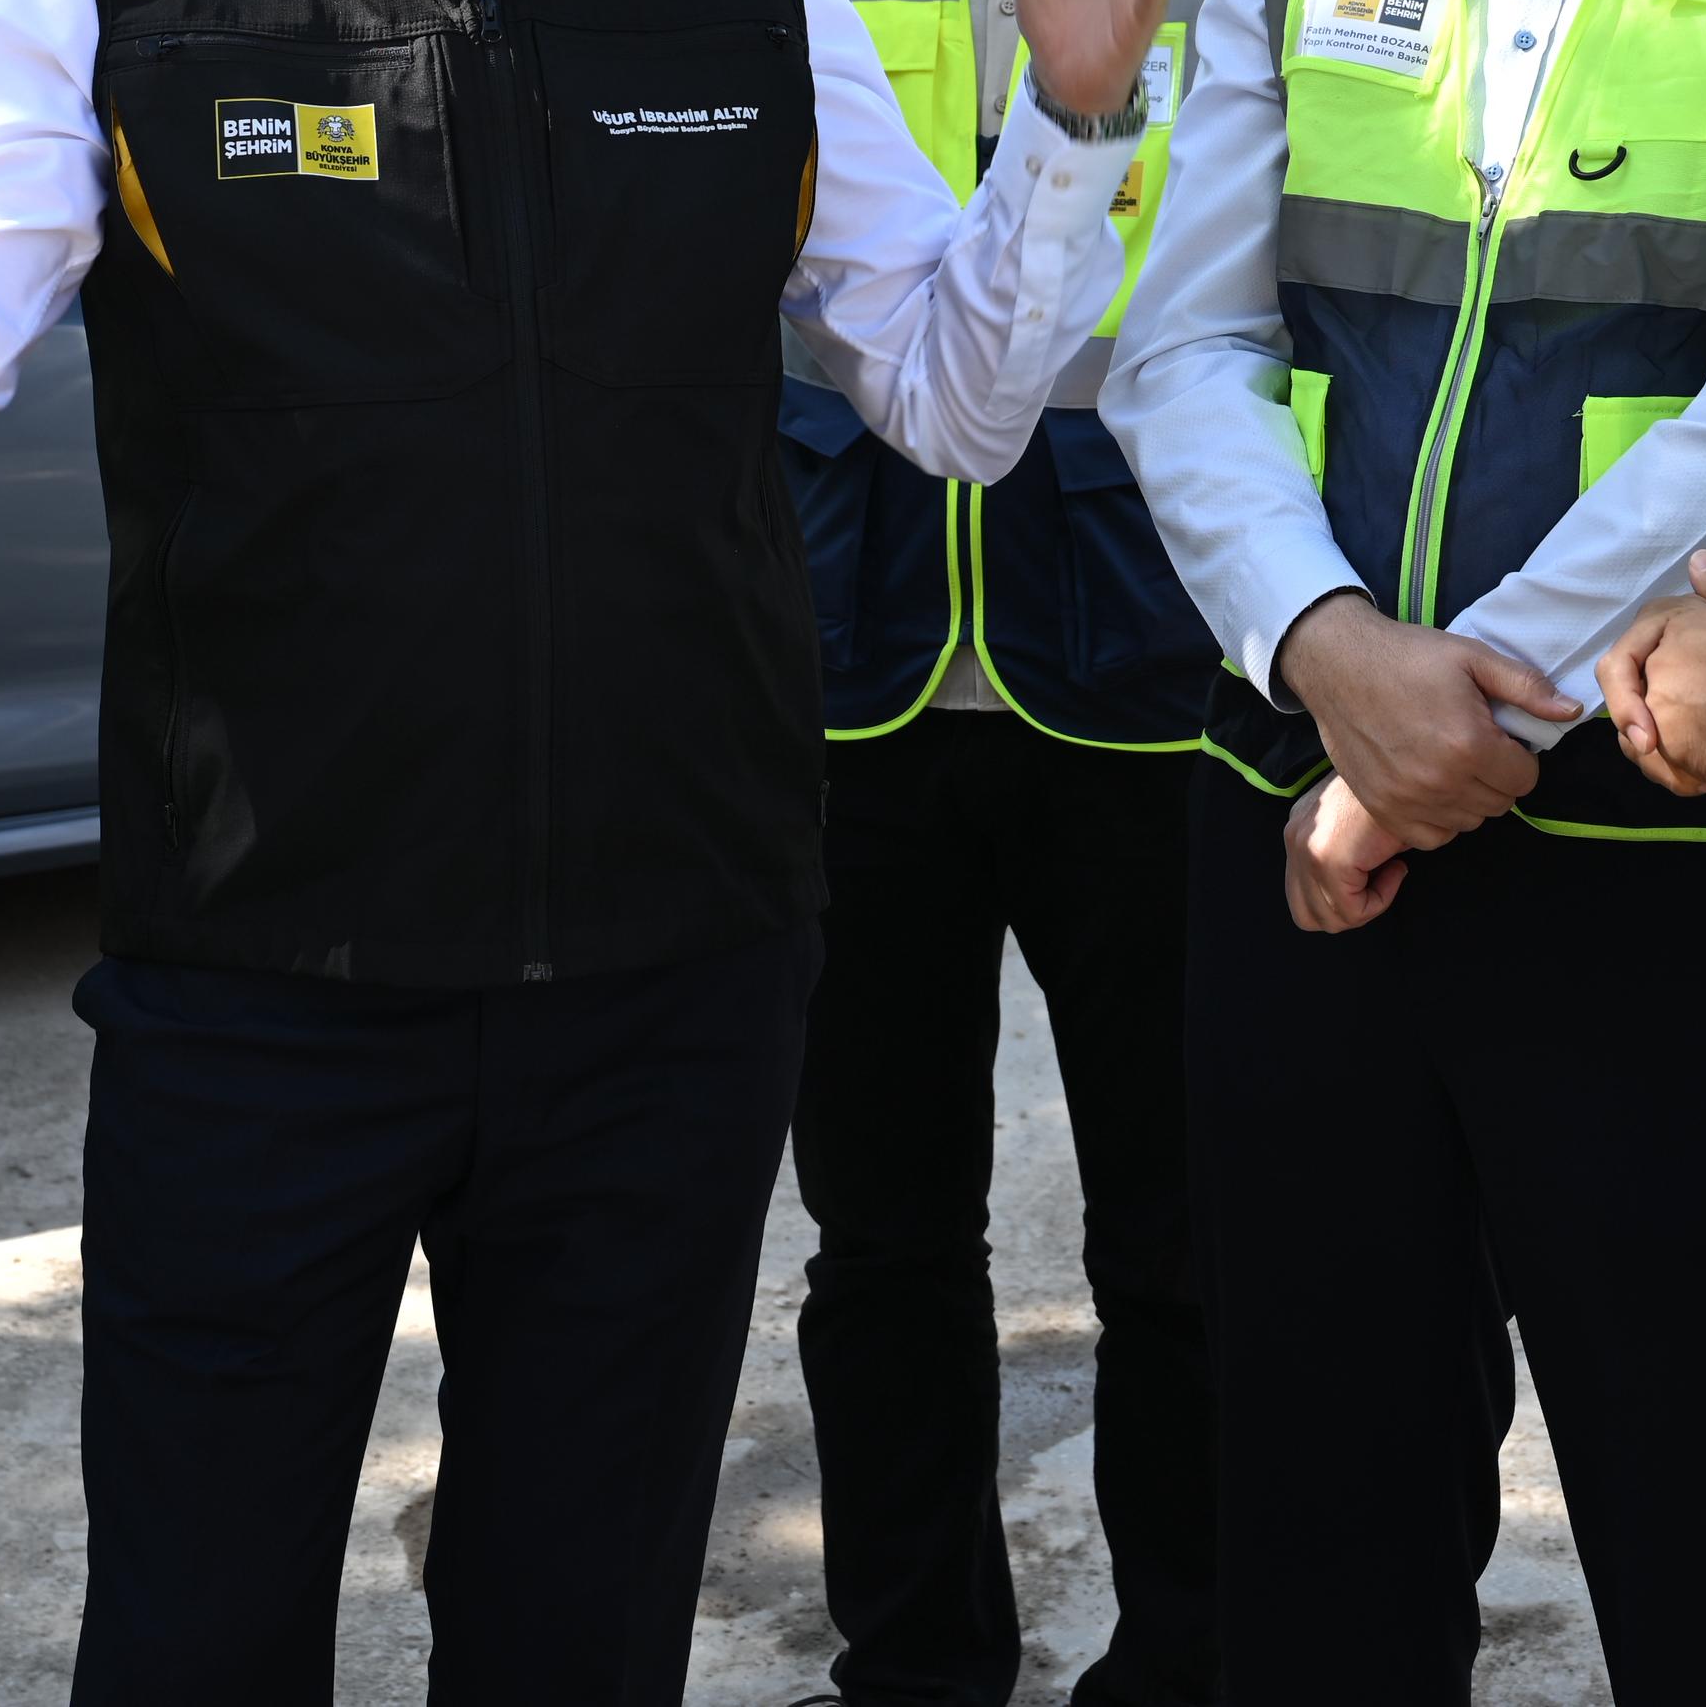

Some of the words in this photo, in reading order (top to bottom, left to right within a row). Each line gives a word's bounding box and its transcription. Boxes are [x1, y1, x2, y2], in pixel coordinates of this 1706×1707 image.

[1306, 27, 1331, 35] Fatih
[1335, 28, 1377, 42] Mehmet
[1381, 36, 1432, 53] BOZABA
[1304, 38, 1323, 46] Yapı
[1326, 39, 1364, 51] Kontrol
[1367, 45, 1394, 57] Daire
[1142, 61, 1167, 72] ZER
[593, 110, 637, 125] UĞUR
[640, 108, 709, 123] İBRAHİM
[713, 107, 759, 121] ALTAY
[610, 127, 635, 135] Konya
[681, 125, 715, 133] Belediye
[321, 145, 353, 154] KONYA
[306, 151, 370, 165] BÜYÜKŞEHİR
[319, 163, 357, 172] BELEDİYESİ
